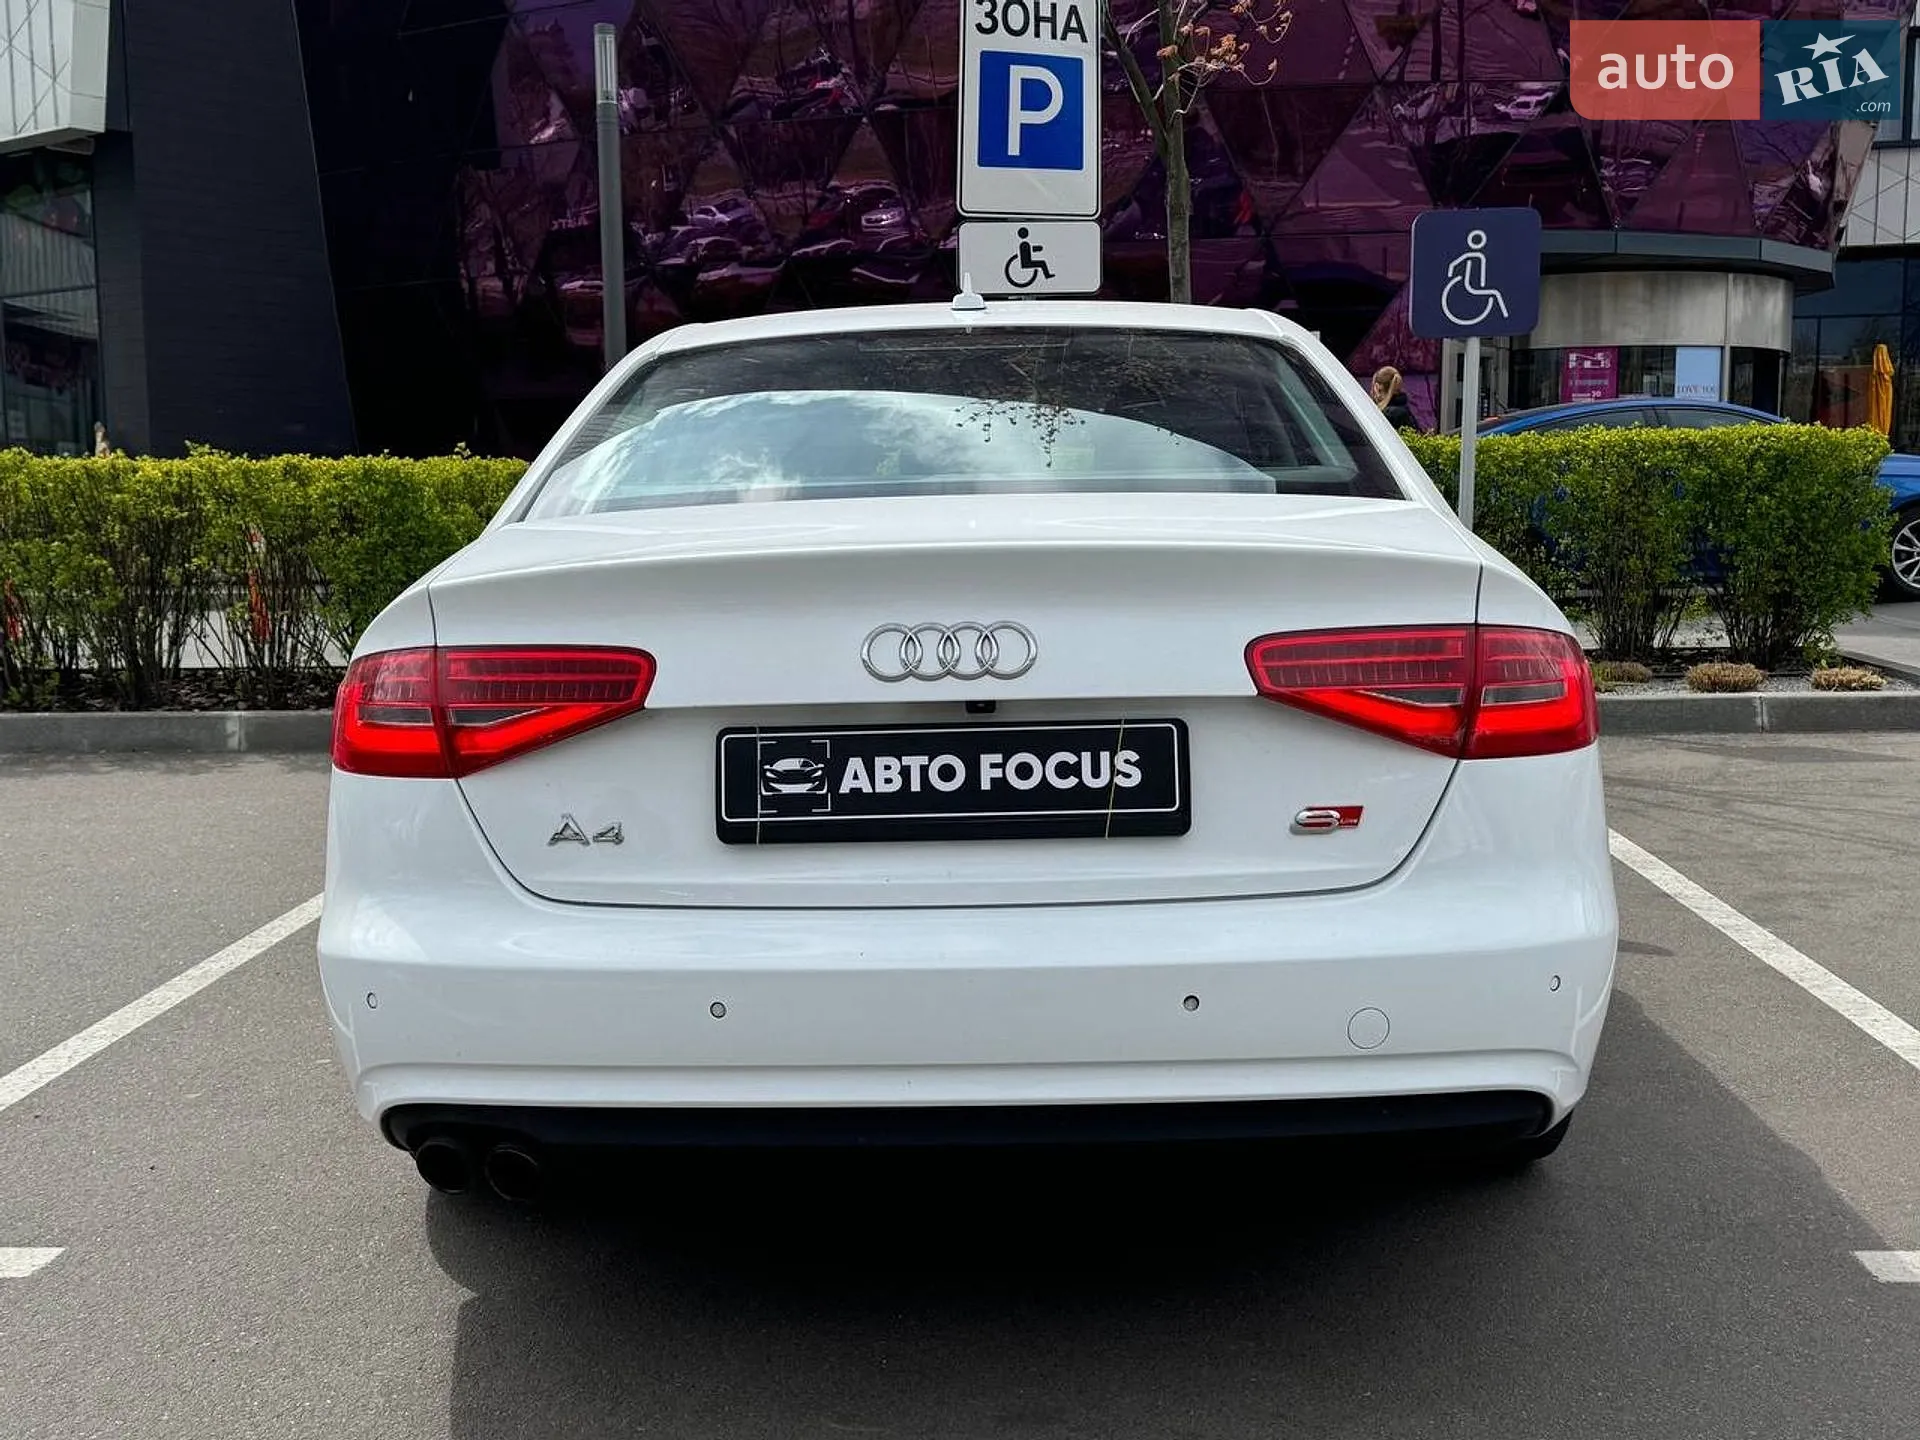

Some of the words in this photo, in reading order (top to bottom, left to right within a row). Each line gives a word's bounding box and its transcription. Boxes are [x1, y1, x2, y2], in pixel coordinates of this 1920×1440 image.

[975, 0, 1089, 43] ЗОНА
[1008, 64, 1064, 156] P
[838, 753, 967, 794] АВТО
[980, 749, 1143, 791] FOCUS
[547, 812, 625, 847] A4
